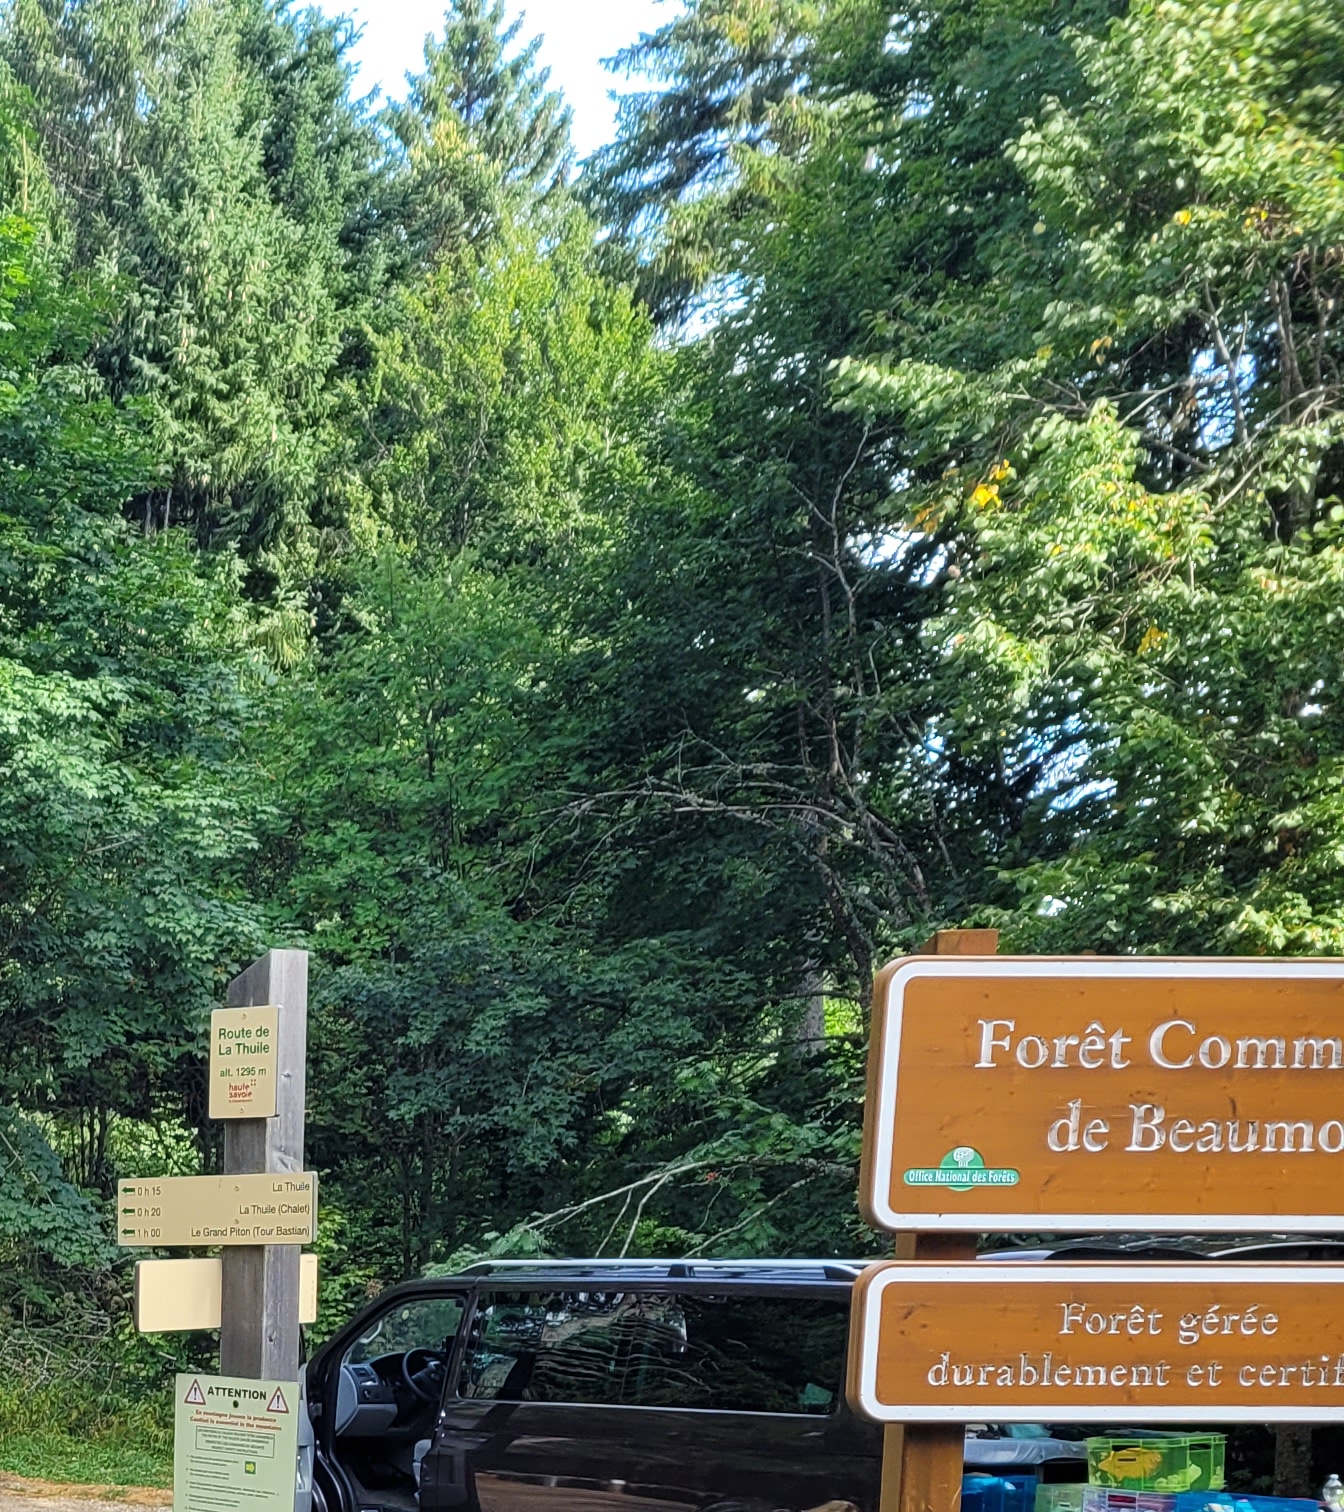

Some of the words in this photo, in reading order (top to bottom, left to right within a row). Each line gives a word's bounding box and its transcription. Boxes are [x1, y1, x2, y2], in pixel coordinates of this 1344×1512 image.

[218, 1027, 252, 1040] Route
[255, 1025, 270, 1038] de
[218, 1043, 232, 1056] La
[235, 1041, 270, 1055] Thuile
[974, 1020, 1131, 1069] Forêt
[1148, 1020, 1344, 1069] Comm
[219, 1067, 233, 1078] alt.
[236, 1066, 256, 1077] 1295
[258, 1068, 267, 1076] m
[228, 1082, 250, 1091] haute
[228, 1091, 253, 1099] savoie
[1048, 1098, 1109, 1153] de
[1124, 1103, 1344, 1153] Beaumo
[908, 1170, 933, 1183] Office
[935, 1169, 970, 1183] National
[972, 1170, 987, 1183] des
[989, 1169, 1015, 1183] Forêts
[137, 1187, 143, 1196] 0
[144, 1186, 149, 1196] h
[152, 1186, 161, 1196] 15
[272, 1182, 283, 1192] La
[285, 1181, 310, 1192] Thuile
[137, 1207, 143, 1217] 0
[144, 1207, 149, 1217] h
[151, 1207, 161, 1217] 20
[240, 1204, 250, 1214] La
[251, 1204, 276, 1214] Thuile
[278, 1203, 310, 1215] (Chalet)
[137, 1228, 141, 1238] 1
[144, 1228, 149, 1238] h
[151, 1228, 161, 1238] 00
[192, 1227, 201, 1237] Le
[203, 1226, 227, 1237] Grand
[230, 1226, 250, 1237] Piton
[253, 1226, 274, 1238] (Tour
[276, 1225, 310, 1237] Bastian)
[1059, 1302, 1163, 1335] Forêt
[1178, 1303, 1279, 1344] gérée
[927, 1352, 1170, 1387] durablement
[1186, 1359, 1223, 1387] et
[207, 1386, 267, 1401] ATTENTION
